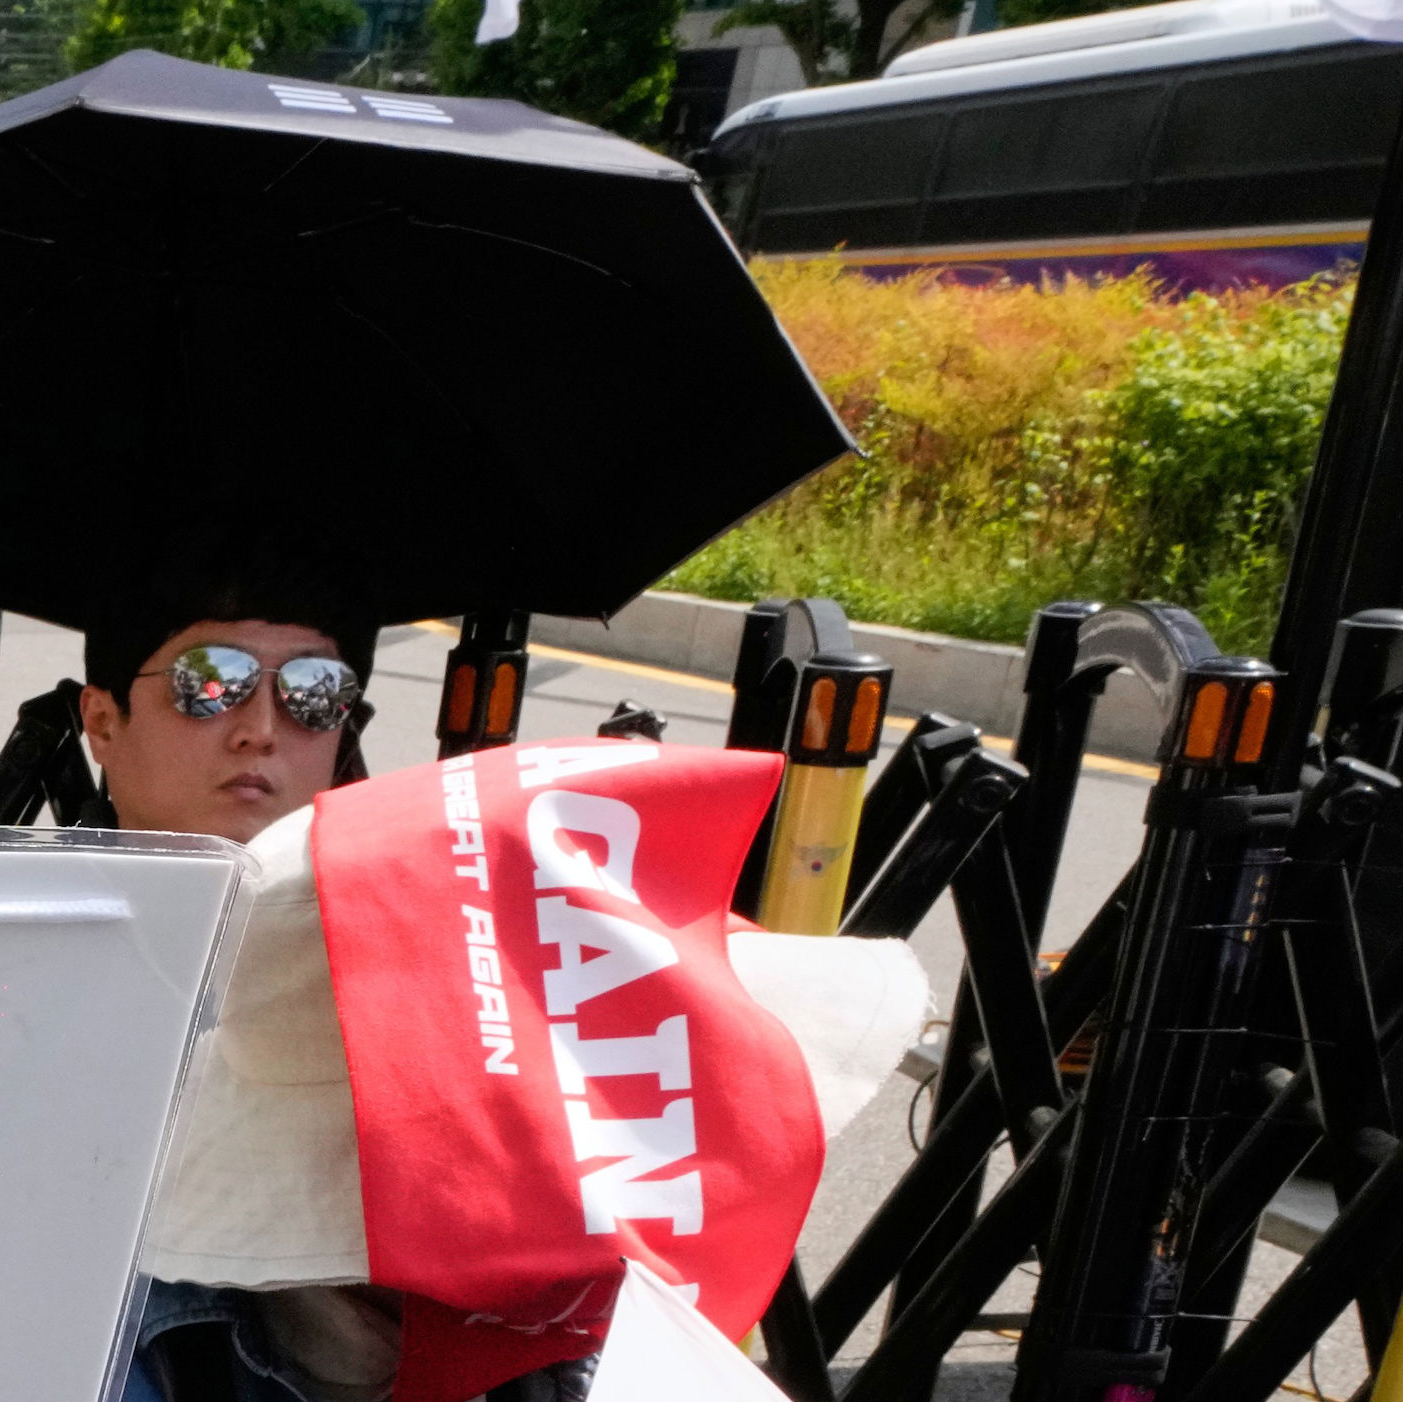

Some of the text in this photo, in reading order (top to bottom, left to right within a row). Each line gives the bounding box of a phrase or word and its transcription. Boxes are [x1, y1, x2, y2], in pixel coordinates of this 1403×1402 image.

[442, 769, 490, 892] GREAT
[461, 903, 519, 1076] AGAIN
[515, 744, 704, 1237] AGAIN
